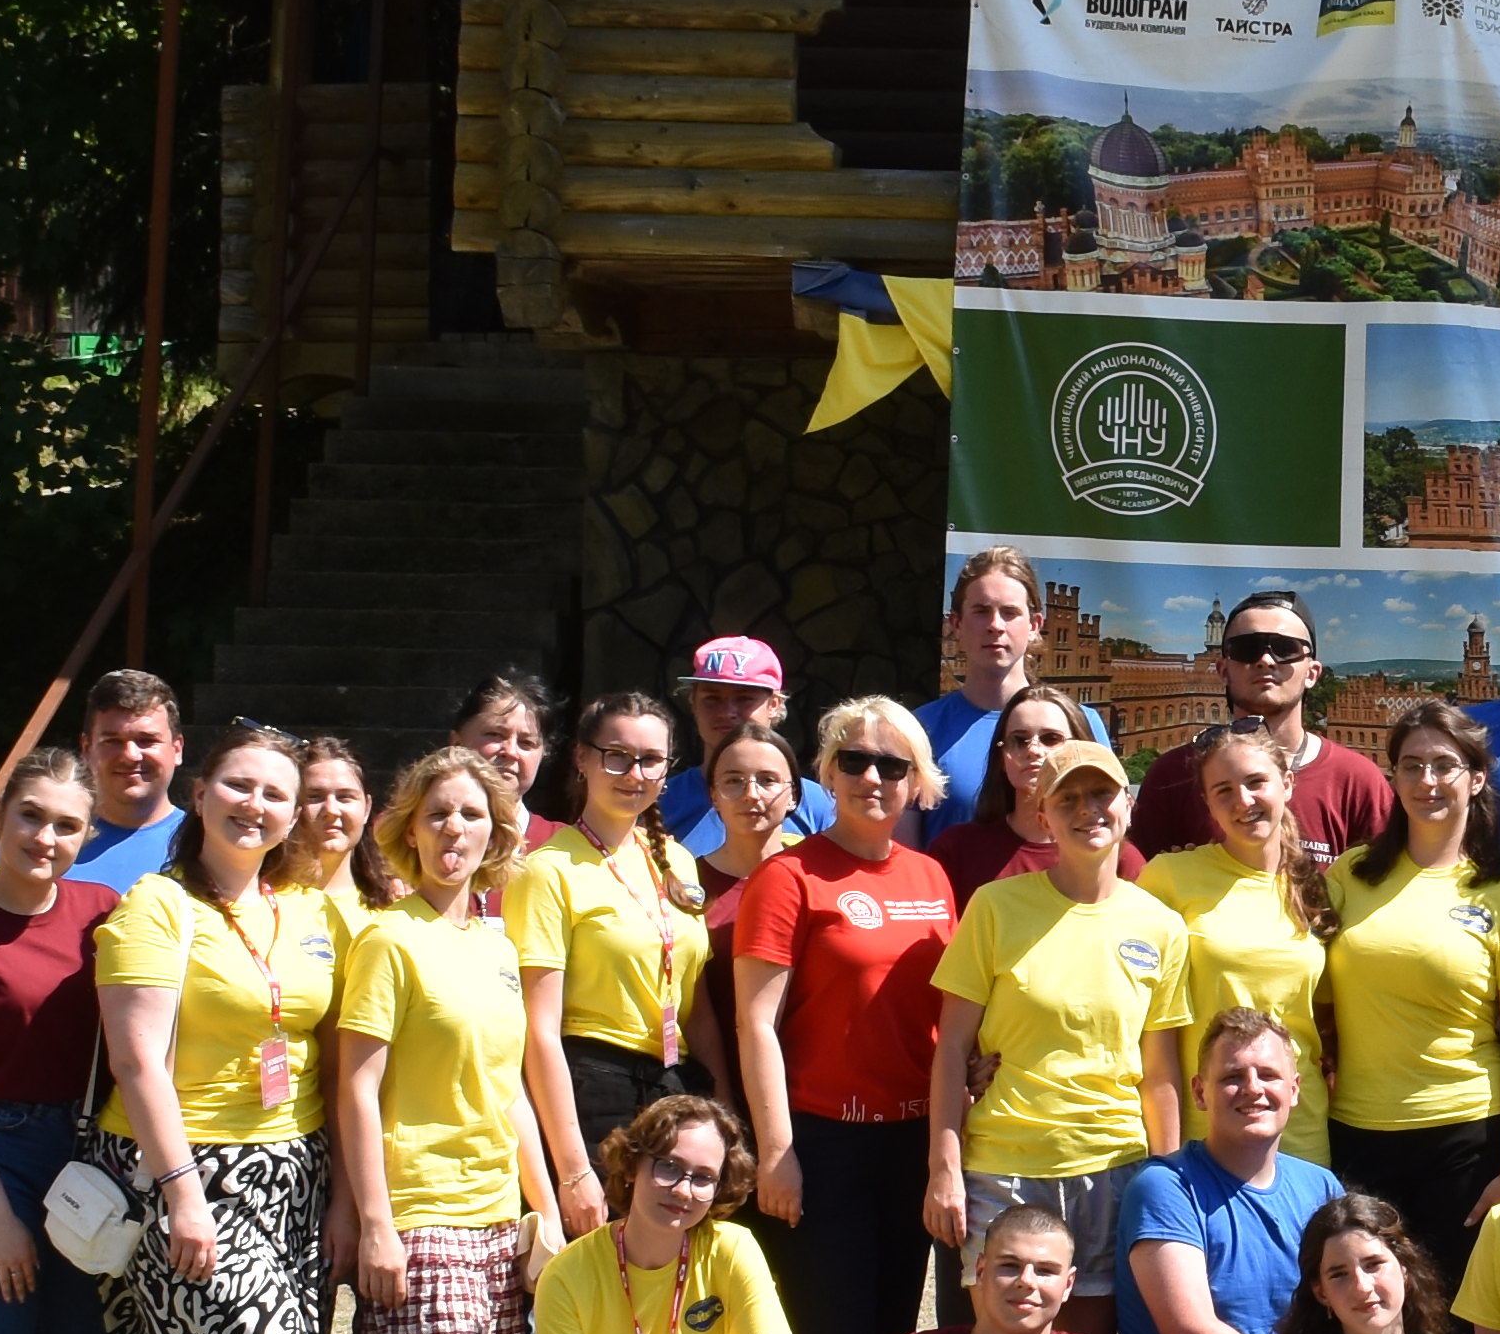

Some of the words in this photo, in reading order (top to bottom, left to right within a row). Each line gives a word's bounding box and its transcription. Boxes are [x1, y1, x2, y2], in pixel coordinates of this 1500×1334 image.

[1215, 17, 1293, 37] ТАЙСТРА
[1061, 370, 1093, 460] ЧЕРНІВЕЦЬКИЙ
[1090, 354, 1186, 385] НАЦІОНАЛЬНИЙ
[1182, 383, 1206, 466] УНІВЕРСИТЕТ
[1098, 424, 1167, 457] ЧНУ
[1073, 475, 1099, 489] ІМЕНІ
[1100, 470, 1123, 481] ЮРІЯ
[1125, 469, 1190, 494] ФЕДЬКОВИЧА
